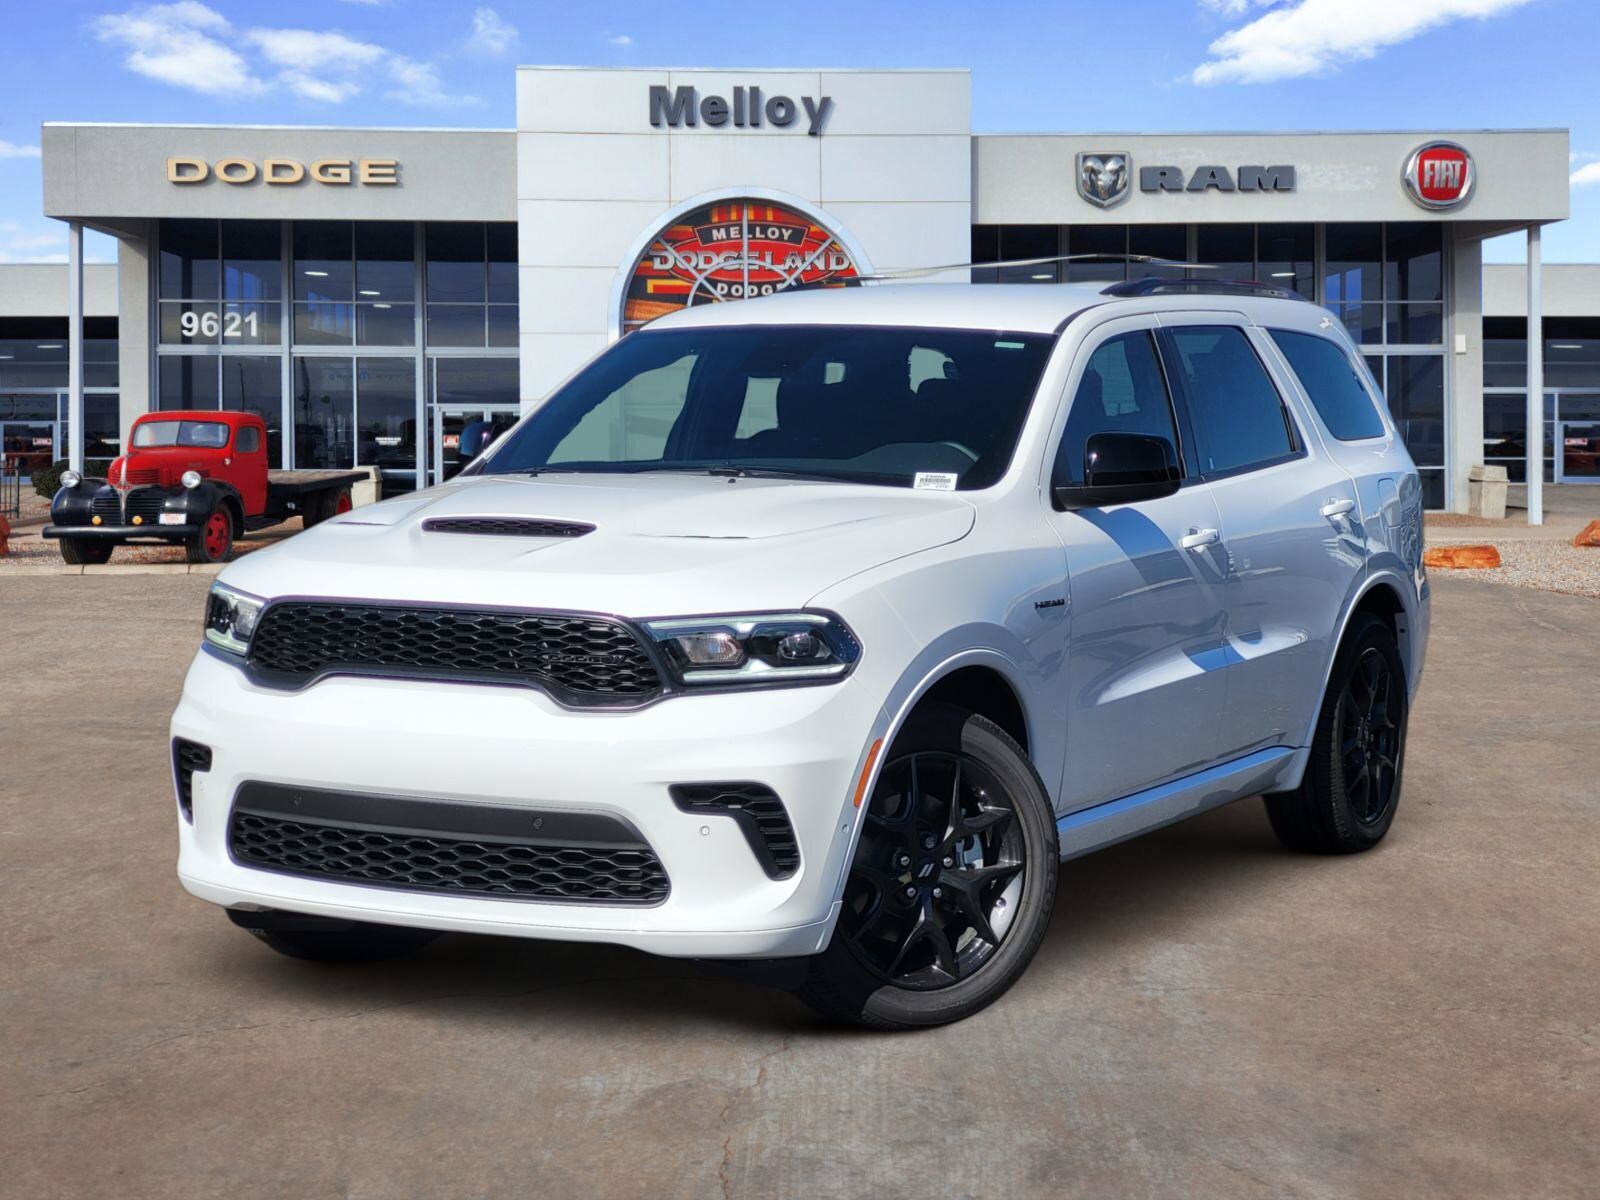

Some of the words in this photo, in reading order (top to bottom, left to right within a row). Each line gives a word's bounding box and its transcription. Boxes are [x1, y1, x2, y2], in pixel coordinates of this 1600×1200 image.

[649, 85, 832, 135] Melloy
[166, 157, 399, 184] DODGE
[1140, 164, 1296, 192] RAM
[1423, 159, 1463, 188] FIAT
[180, 312, 259, 338] 9621
